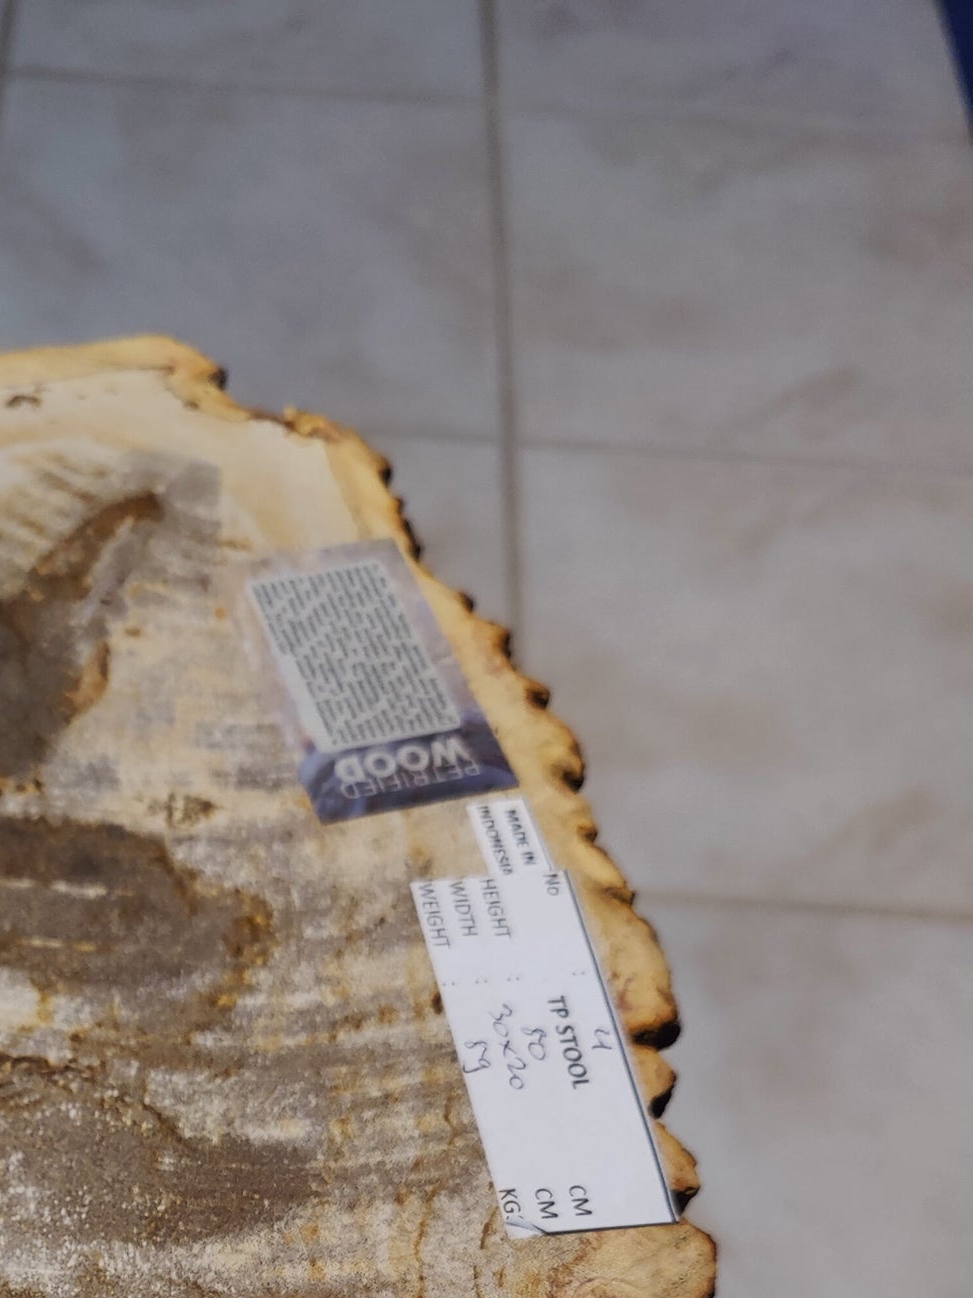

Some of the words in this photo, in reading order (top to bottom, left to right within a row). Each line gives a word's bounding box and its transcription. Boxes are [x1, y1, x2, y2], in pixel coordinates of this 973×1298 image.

[333, 734, 471, 784] WOOD
[340, 758, 482, 799] PETRIFIED
[479, 805, 514, 876] INDONESIA
[506, 809, 530, 847] MADE
[522, 851, 537, 866] IN
[418, 882, 451, 948] WEIGHT
[547, 995, 570, 1018] TP
[449, 881, 479, 937] WIDTH
[534, 1188, 559, 1219] CM
[479, 878, 513, 938] HEIGHT
[569, 1185, 593, 1216] CM
[555, 1025, 590, 1090] STOOL
